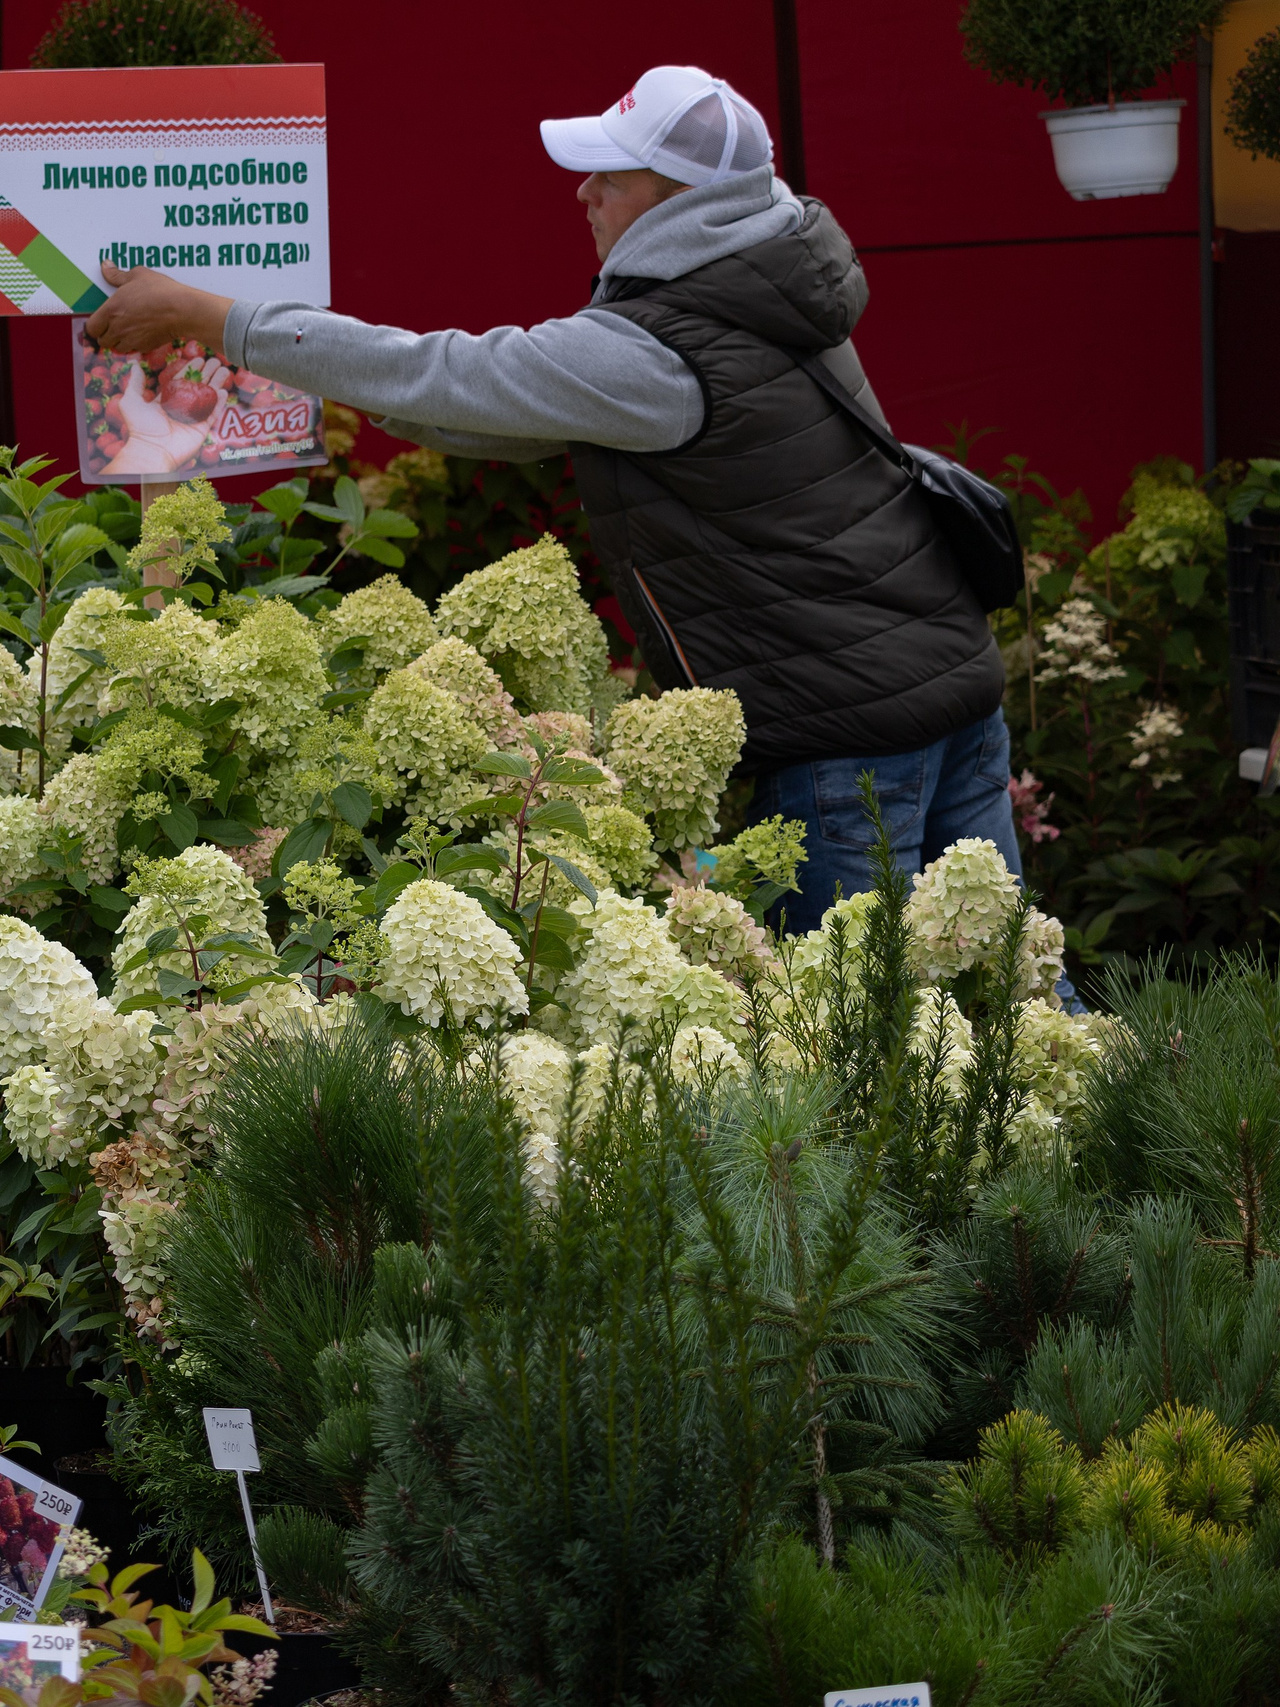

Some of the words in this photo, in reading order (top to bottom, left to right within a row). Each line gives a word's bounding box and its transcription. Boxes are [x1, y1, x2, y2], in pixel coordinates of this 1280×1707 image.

[43, 163, 147, 190] Личное
[154, 159, 308, 190] подсобное
[164, 197, 309, 227] хозяйство
[100, 242, 211, 269] «Красна
[219, 242, 310, 268] ягода»
[219, 404, 309, 439] Азия
